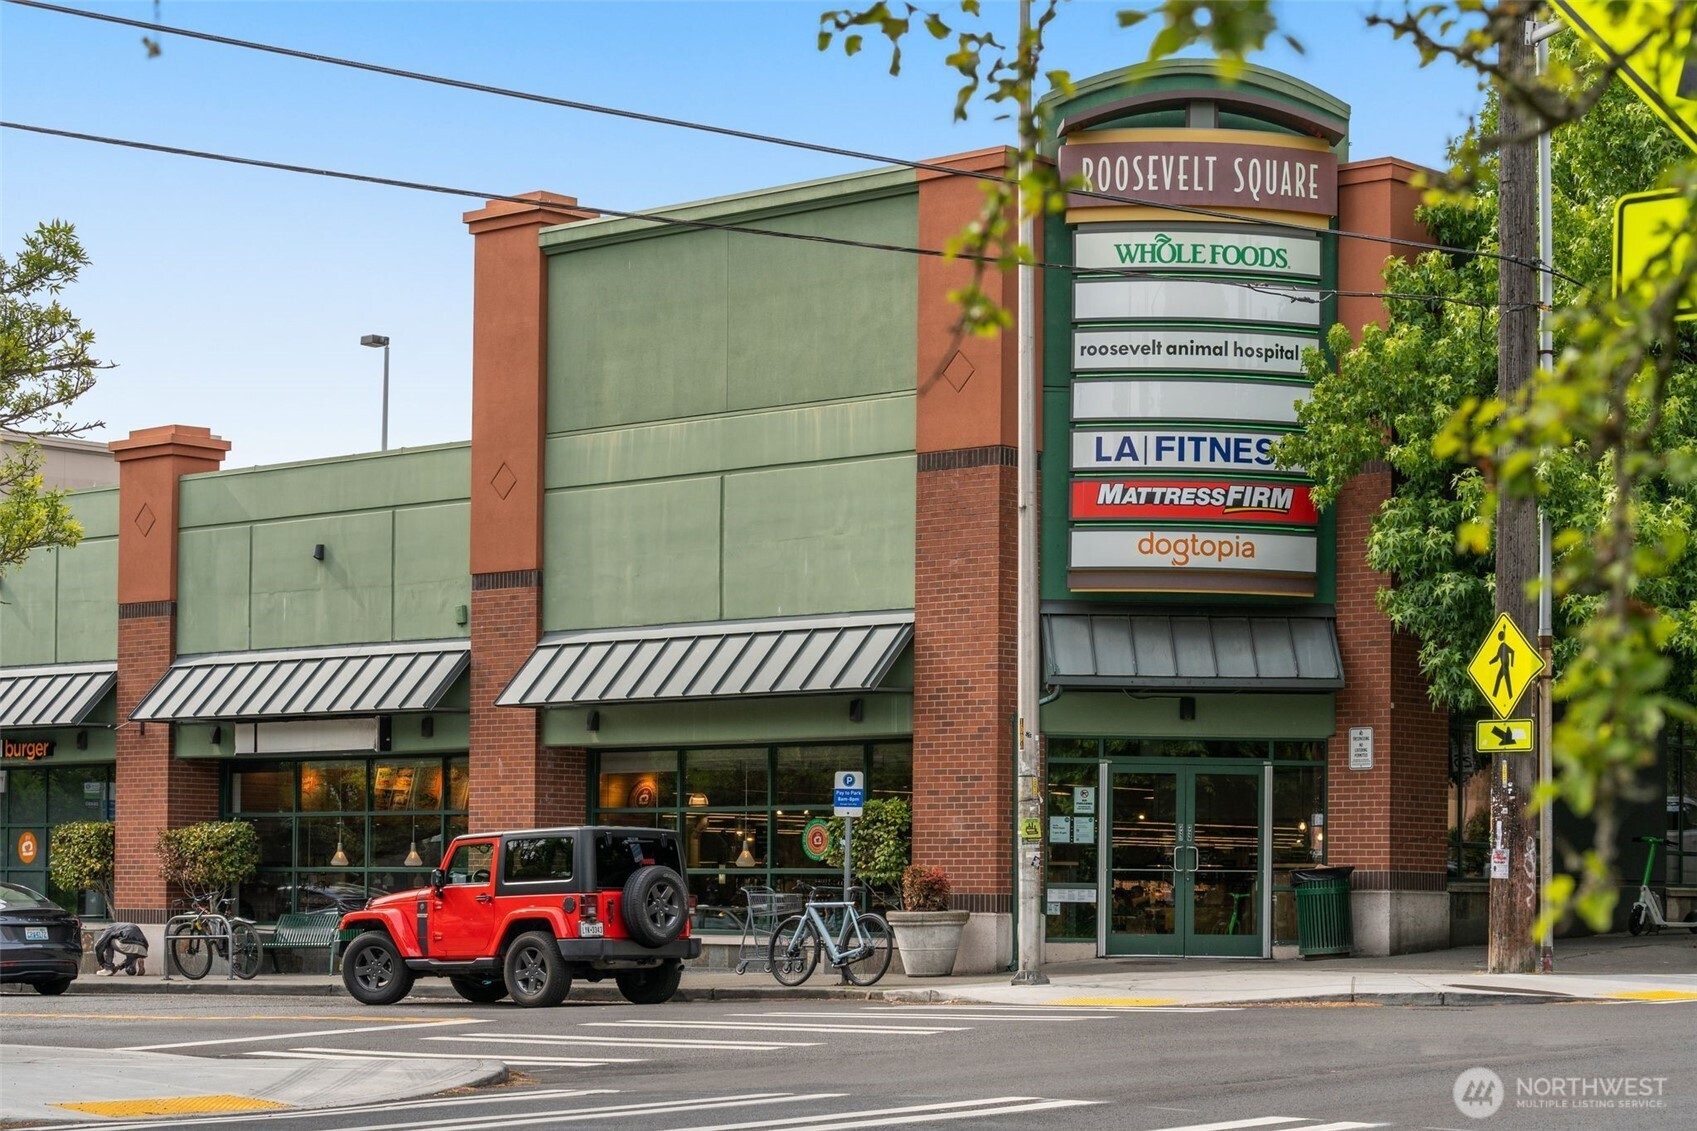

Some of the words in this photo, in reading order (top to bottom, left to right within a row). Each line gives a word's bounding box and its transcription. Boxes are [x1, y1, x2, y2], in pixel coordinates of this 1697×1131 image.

[1082, 155, 1218, 193] ROOSEVELT
[1233, 157, 1319, 202] SQUARE
[1114, 234, 1206, 265] WHOLE
[1209, 244, 1289, 269] FOODS
[1080, 339, 1163, 357] roosevelt
[1166, 340, 1229, 358] animal
[1233, 342, 1299, 362] hospital
[1095, 436, 1140, 462] LA
[1155, 436, 1286, 466] FITNES
[1137, 532, 1256, 566] dogtopia
[5, 739, 49, 761] burger
[846, 776, 853, 785] P
